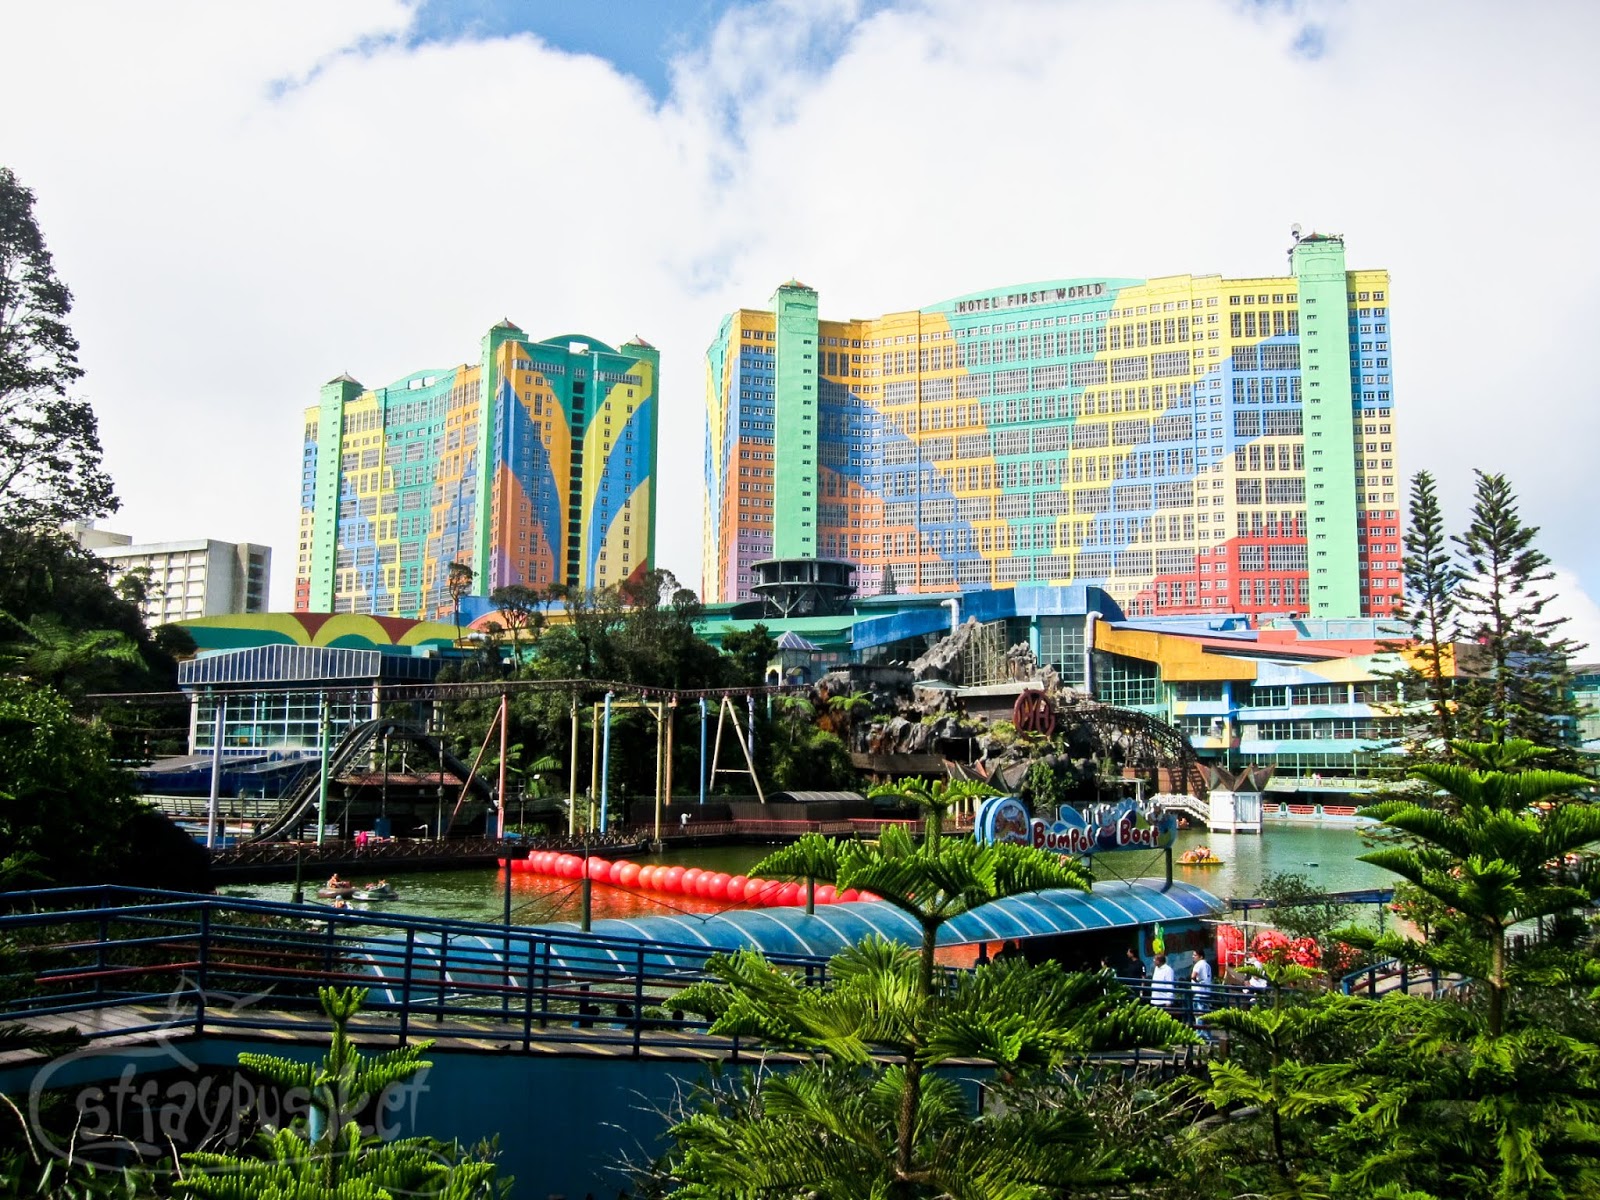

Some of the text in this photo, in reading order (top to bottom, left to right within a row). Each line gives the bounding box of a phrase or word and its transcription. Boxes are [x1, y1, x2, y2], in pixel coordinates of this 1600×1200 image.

[959, 283, 1102, 312] HOTEL FIRST WORLD
[1118, 818, 1160, 847] Boat
